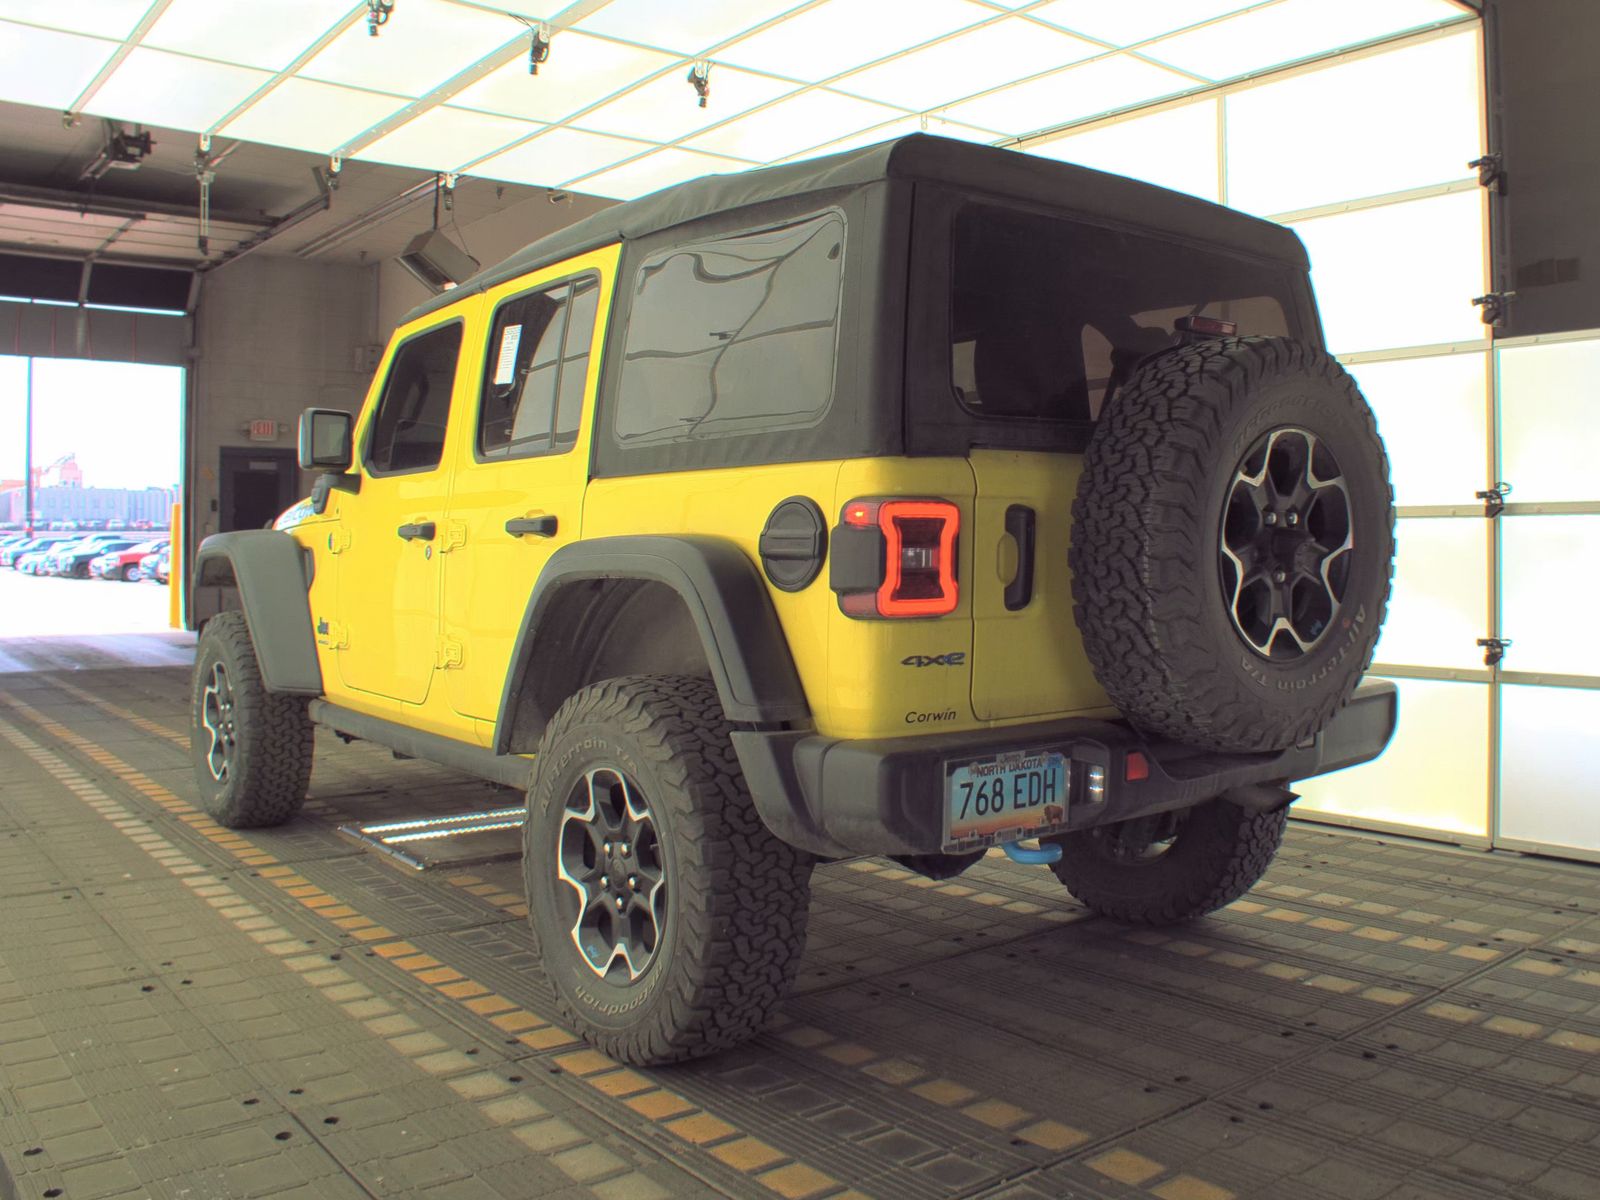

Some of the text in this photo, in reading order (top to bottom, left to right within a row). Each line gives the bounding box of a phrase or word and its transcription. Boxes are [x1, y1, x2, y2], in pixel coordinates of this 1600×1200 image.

[905, 708, 956, 723] Corwin
[976, 764, 1006, 778] NORTH
[1009, 757, 1042, 772] DAKOTA
[960, 767, 1056, 820] 768 EDH
